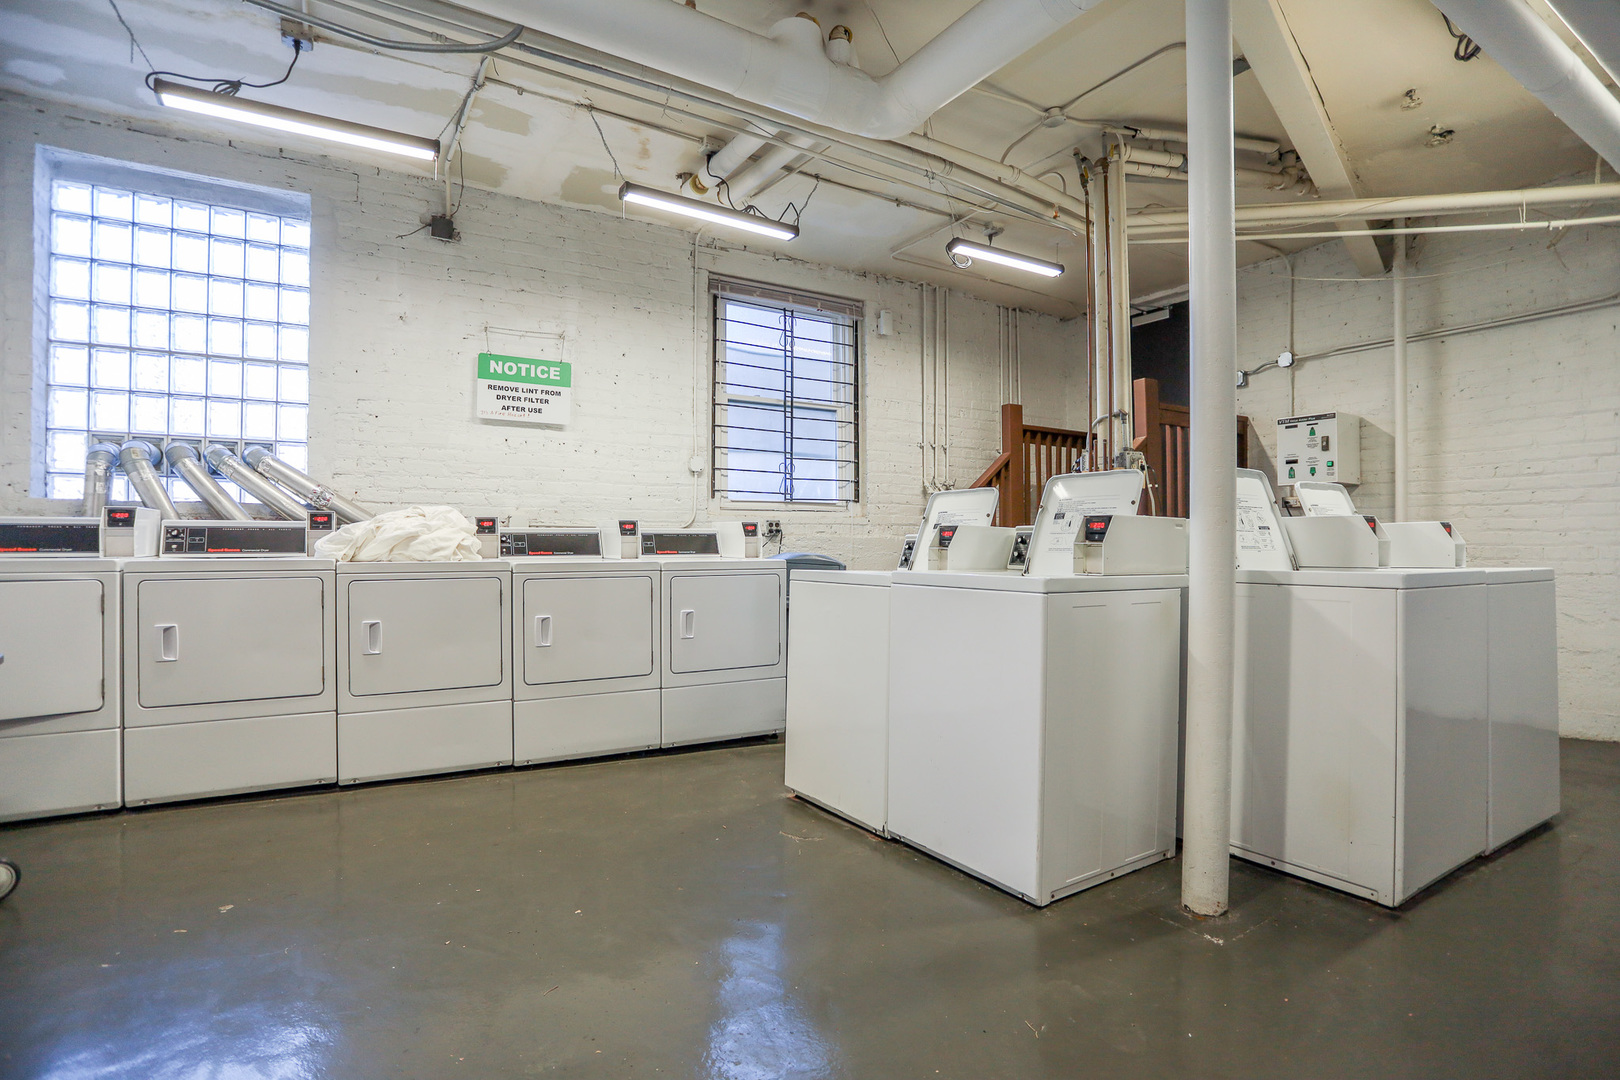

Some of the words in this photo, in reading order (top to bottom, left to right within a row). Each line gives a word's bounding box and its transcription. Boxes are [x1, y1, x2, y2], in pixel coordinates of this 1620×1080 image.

[489, 359, 561, 380] NOTICE
[487, 383, 520, 393] REMOVE
[521, 387, 539, 395] LINT
[540, 389, 562, 397] FROM
[496, 394, 522, 402] DRYER
[523, 397, 550, 405] FILTER
[501, 404, 526, 413] AFTER
